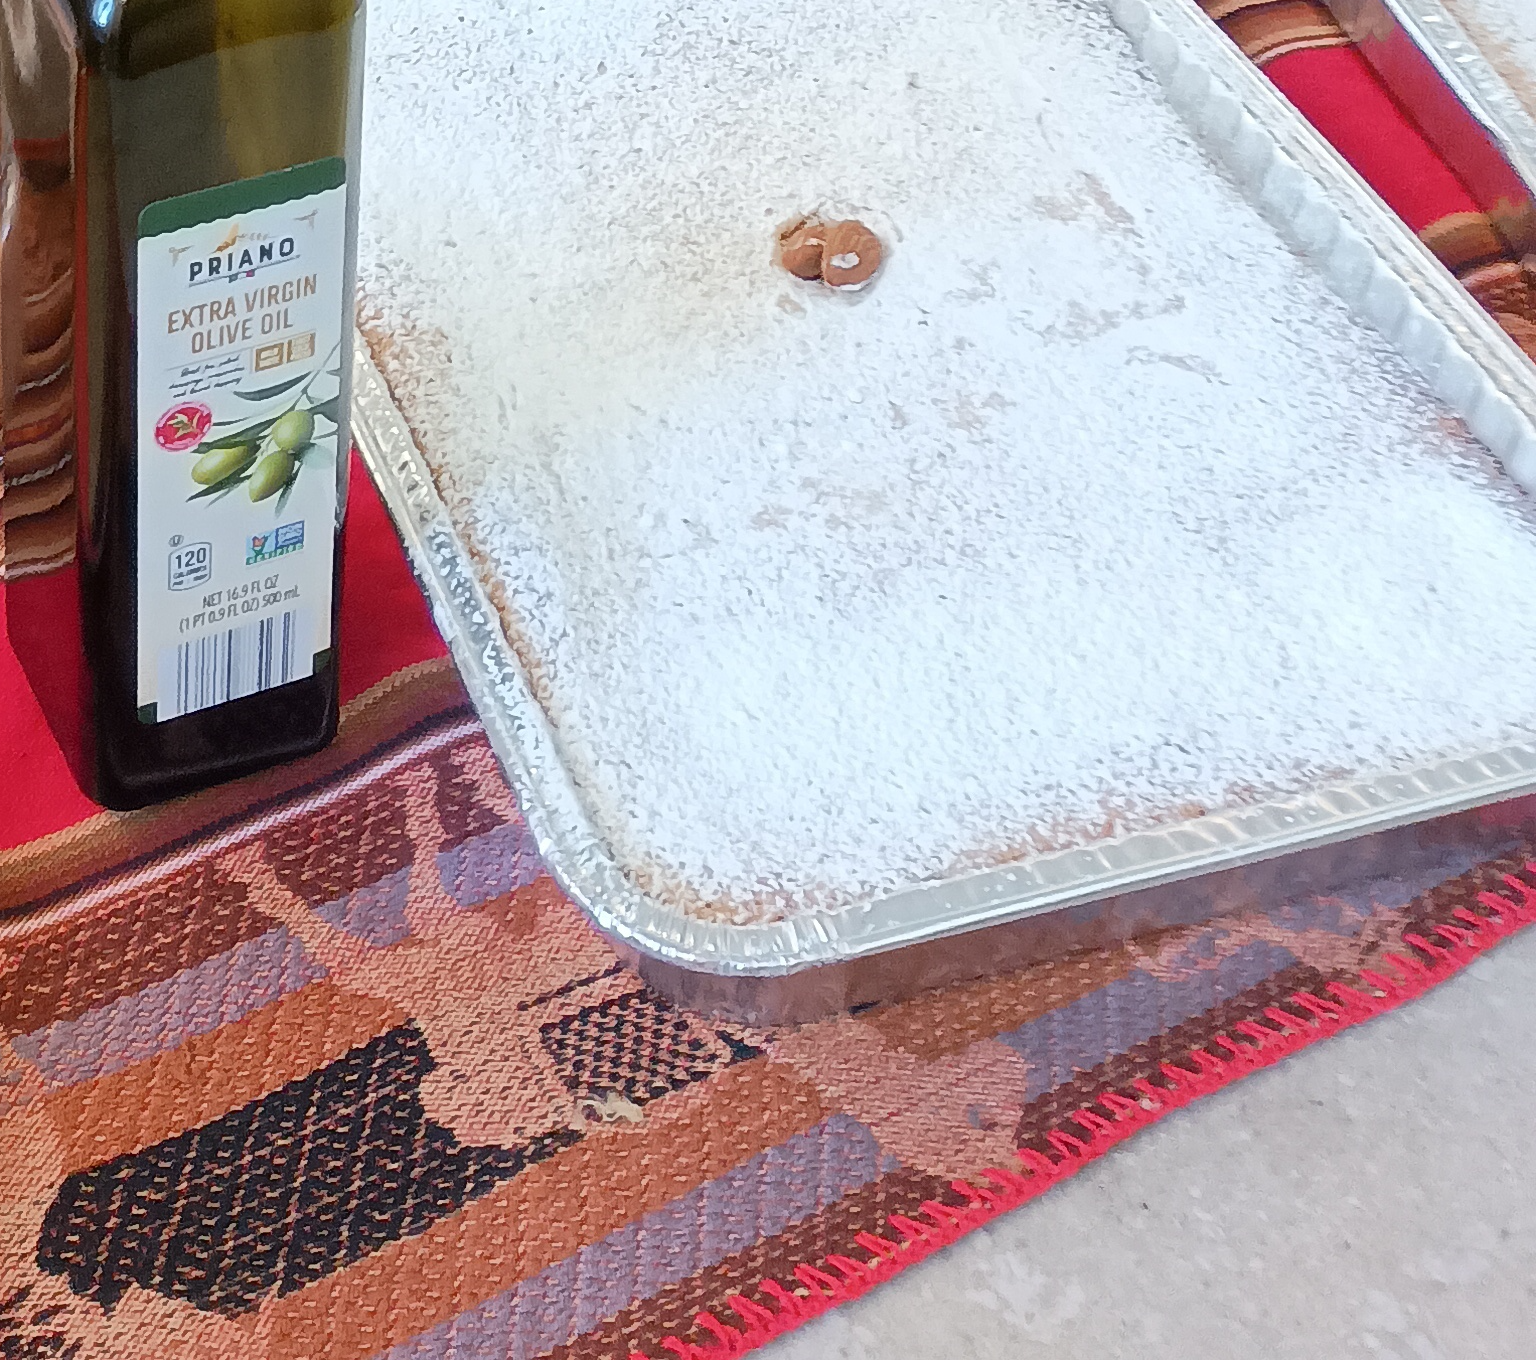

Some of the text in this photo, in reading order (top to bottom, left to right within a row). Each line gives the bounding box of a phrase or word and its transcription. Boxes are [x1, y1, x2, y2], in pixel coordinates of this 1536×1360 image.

[189, 237, 295, 282] PRIANO
[167, 273, 318, 334] EXTRA VIRGIN
[191, 316, 254, 354] OLIVE
[260, 307, 294, 335] OIL
[175, 547, 207, 570] 120
[202, 591, 223, 609] NET
[251, 579, 262, 594] FL
[264, 573, 279, 590] OZ
[227, 603, 239, 619] FL
[261, 590, 282, 609] 500
